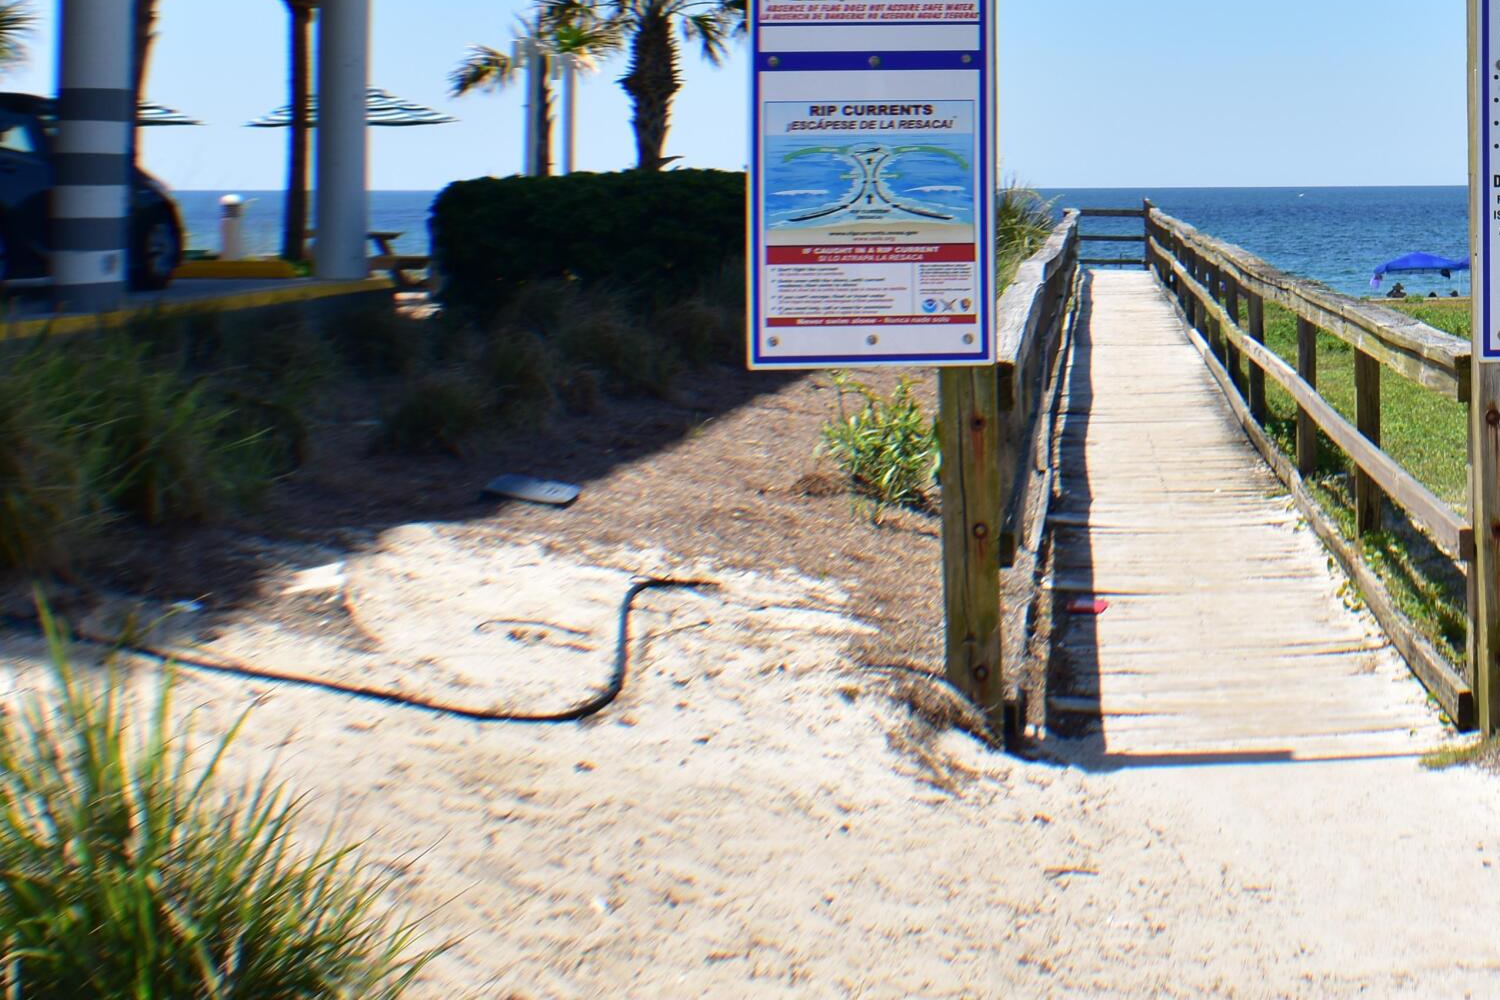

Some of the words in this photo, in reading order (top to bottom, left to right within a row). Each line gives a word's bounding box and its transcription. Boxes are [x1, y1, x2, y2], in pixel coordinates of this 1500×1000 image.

[809, 104, 837, 116] RIP
[842, 104, 933, 116] CURRENTS
[859, 119, 877, 130] DE
[879, 119, 895, 130] LA
